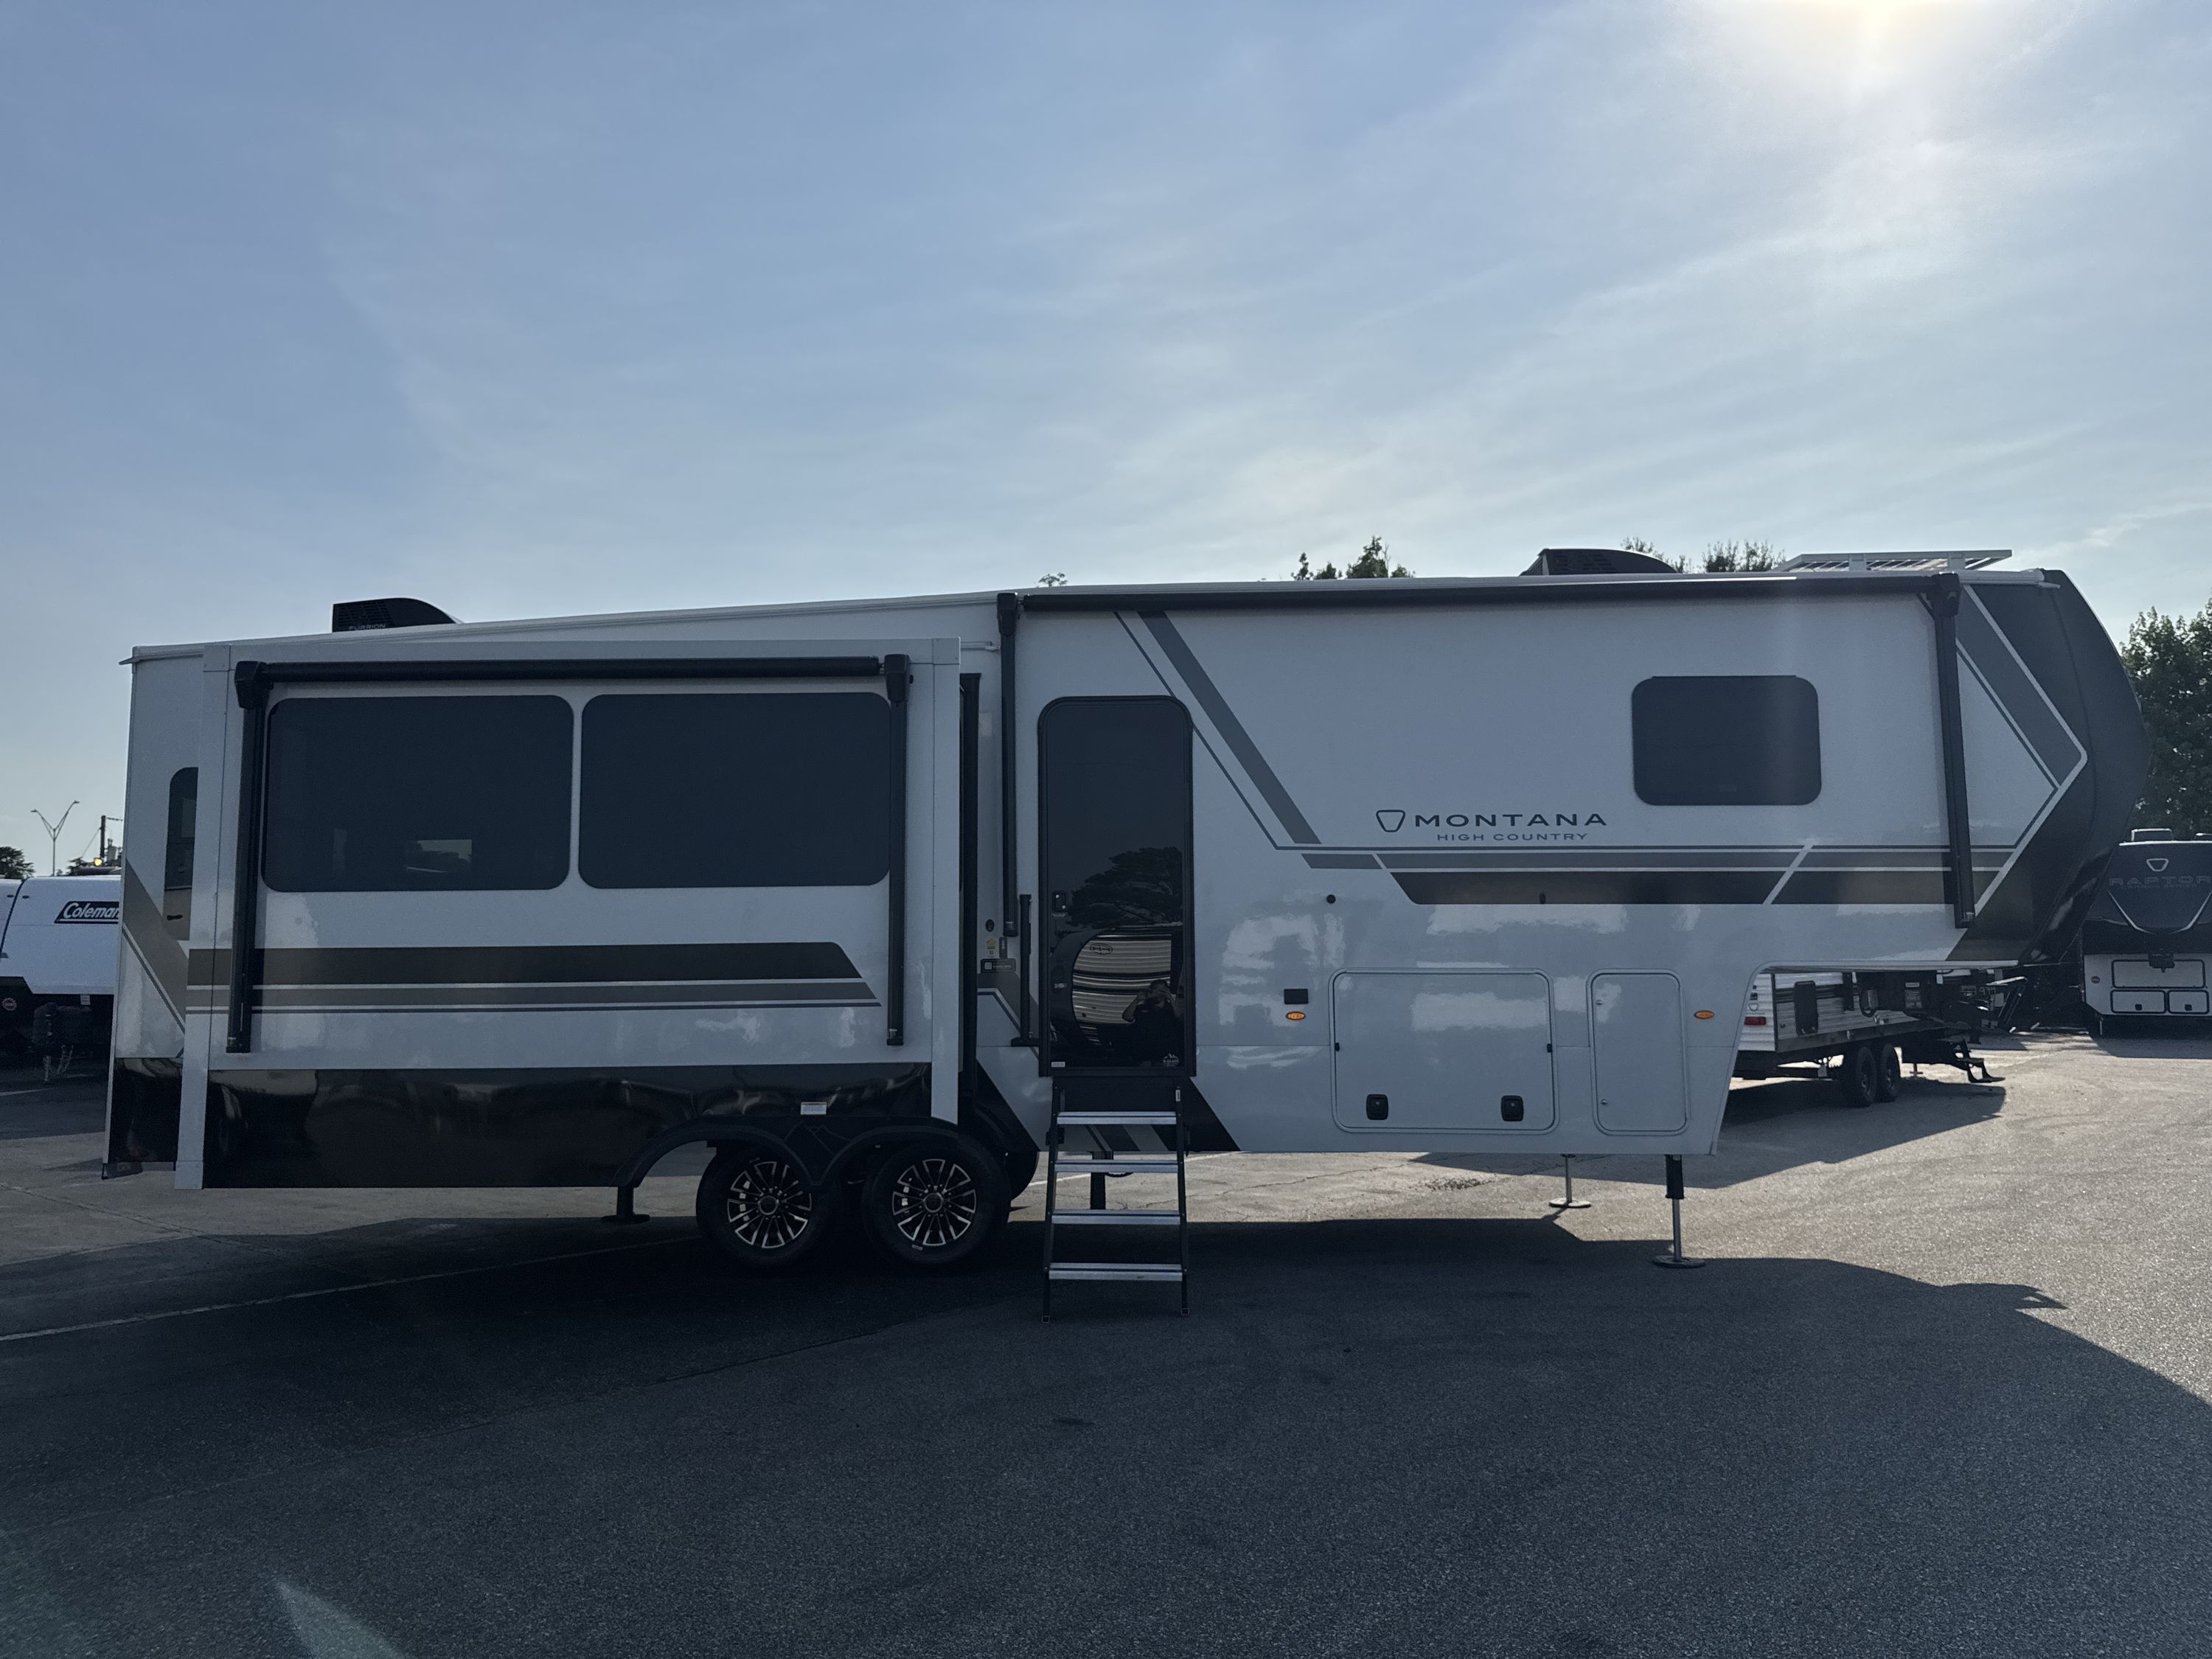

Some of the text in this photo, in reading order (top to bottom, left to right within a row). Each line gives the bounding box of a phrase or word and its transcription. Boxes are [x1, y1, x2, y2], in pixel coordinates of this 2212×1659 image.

[1415, 813, 1607, 827] MONTANA
[1437, 833, 1588, 841] HIGH COUNTRY
[2110, 875, 2211, 886] RAPTOR
